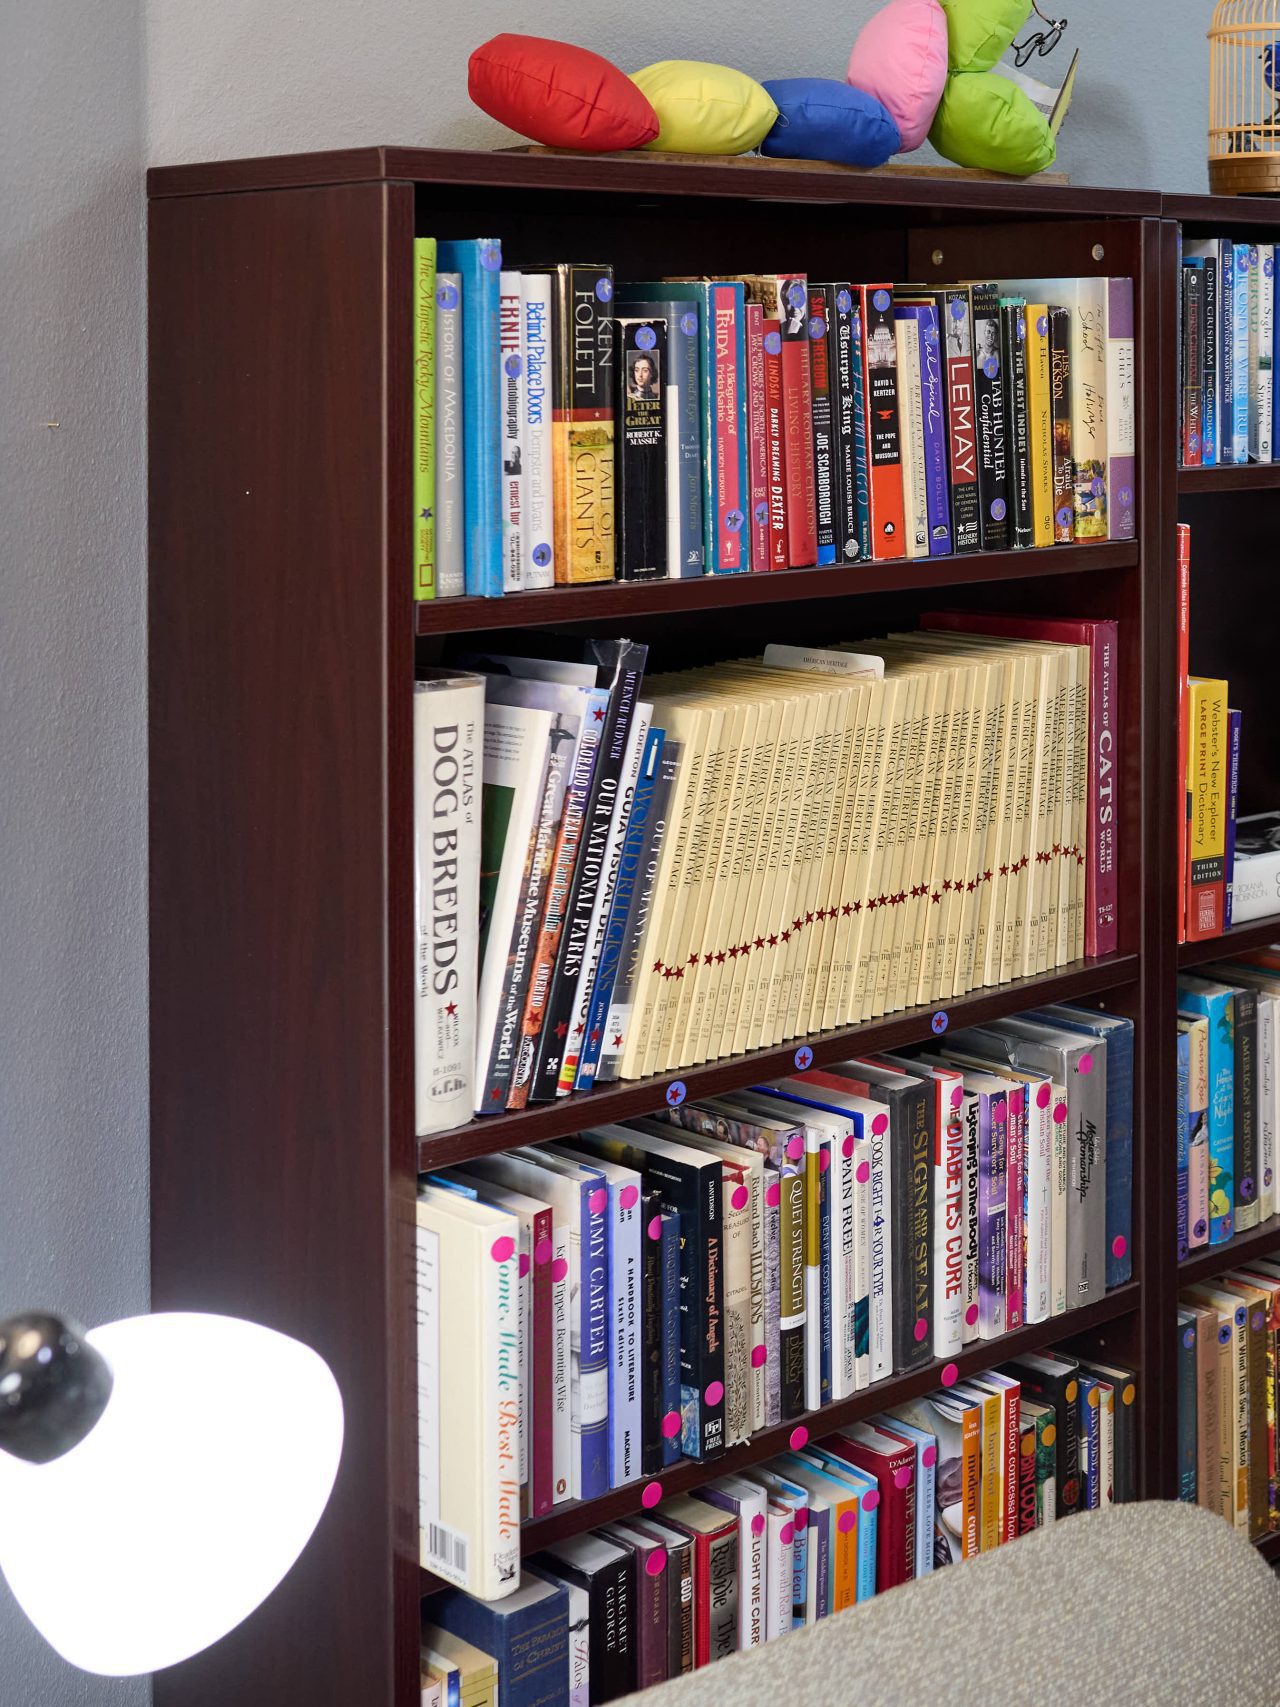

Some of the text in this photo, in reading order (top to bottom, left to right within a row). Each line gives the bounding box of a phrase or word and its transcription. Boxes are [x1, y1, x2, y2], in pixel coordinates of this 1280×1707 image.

[1206, 268, 1214, 300] JOHN
[500, 295, 520, 353] ERNIE
[575, 290, 594, 393] FOLLETT
[598, 316, 612, 366] KEN
[716, 309, 734, 358] FRIDA
[527, 302, 545, 424] Behind Palace Doors
[717, 364, 726, 422] Frida Kahlo
[874, 389, 895, 397] KERTZER
[1053, 350, 1064, 399] JACKSON
[506, 377, 518, 440] autobiography
[626, 399, 660, 411] PETER
[626, 417, 661, 426] GREAT
[725, 373, 735, 422] Biography
[727, 424, 736, 435] of
[952, 363, 974, 477] LEMAY
[981, 394, 994, 468] Confidential
[991, 377, 1006, 481] TAB HUNTER
[1015, 351, 1026, 453] THE WEST INDIES
[768, 360, 785, 530] LINDSAY DARKLY DREAMING DEXTER
[788, 388, 801, 498] LIVING HISTORY
[801, 349, 814, 535] HILLARY RODHAM CLINTON
[1063, 458, 1071, 489] Afraid
[575, 452, 596, 549] GIANTS
[600, 458, 612, 537] FALL OF
[816, 433, 831, 525] JOE SCARBOROUGH
[933, 442, 944, 519] DAVID BOLLIER
[1103, 712, 1109, 727] OF
[1199, 699, 1207, 738] LARGE
[1099, 729, 1112, 825] CATS
[1209, 699, 1221, 841] Webster's New Explorer
[543, 729, 599, 933] COLORADO PLATEAU Wild and Beautiful
[668, 752, 701, 892] AMERICAN HERITAGE
[1106, 828, 1112, 844] OF
[1196, 783, 1208, 846] Dictionary
[432, 725, 459, 996] DOG BREEDS
[563, 778, 619, 978] OUR NATIONAL PARKS
[1193, 871, 1222, 881] EDITION
[1197, 862, 1218, 870] THIRD
[498, 771, 558, 1061] Great Maritime Museums of the World
[531, 962, 550, 1008] ANNERINO
[842, 1157, 853, 1251] PAIN FREE
[871, 1134, 883, 1299] COOK RIGHT YOUR TYPE
[946, 1124, 962, 1299] DIABETES CURE
[627, 1257, 635, 1265] A
[750, 1177, 762, 1325] Richard Bach ILLUSIONS
[789, 1179, 803, 1310] QUIET STRENGTH
[822, 1215, 832, 1352] EVEN IF IT COSTS ME MY LIFE
[617, 1297, 625, 1367] Sixth Edition
[627, 1332, 634, 1346] TO
[627, 1349, 635, 1402] LITERATURE
[1237, 1325, 1247, 1466] The Wind That Mexico
[967, 1455, 978, 1513] modern
[681, 1577, 692, 1601] GOD
[711, 1541, 734, 1609] Rushdie
[751, 1540, 760, 1605] LIGHT WE
[793, 1538, 806, 1600] Big Year
[606, 1587, 615, 1651] GEORGE
[618, 1570, 627, 1655] MARGARET
[682, 1606, 691, 1657] Delusion
